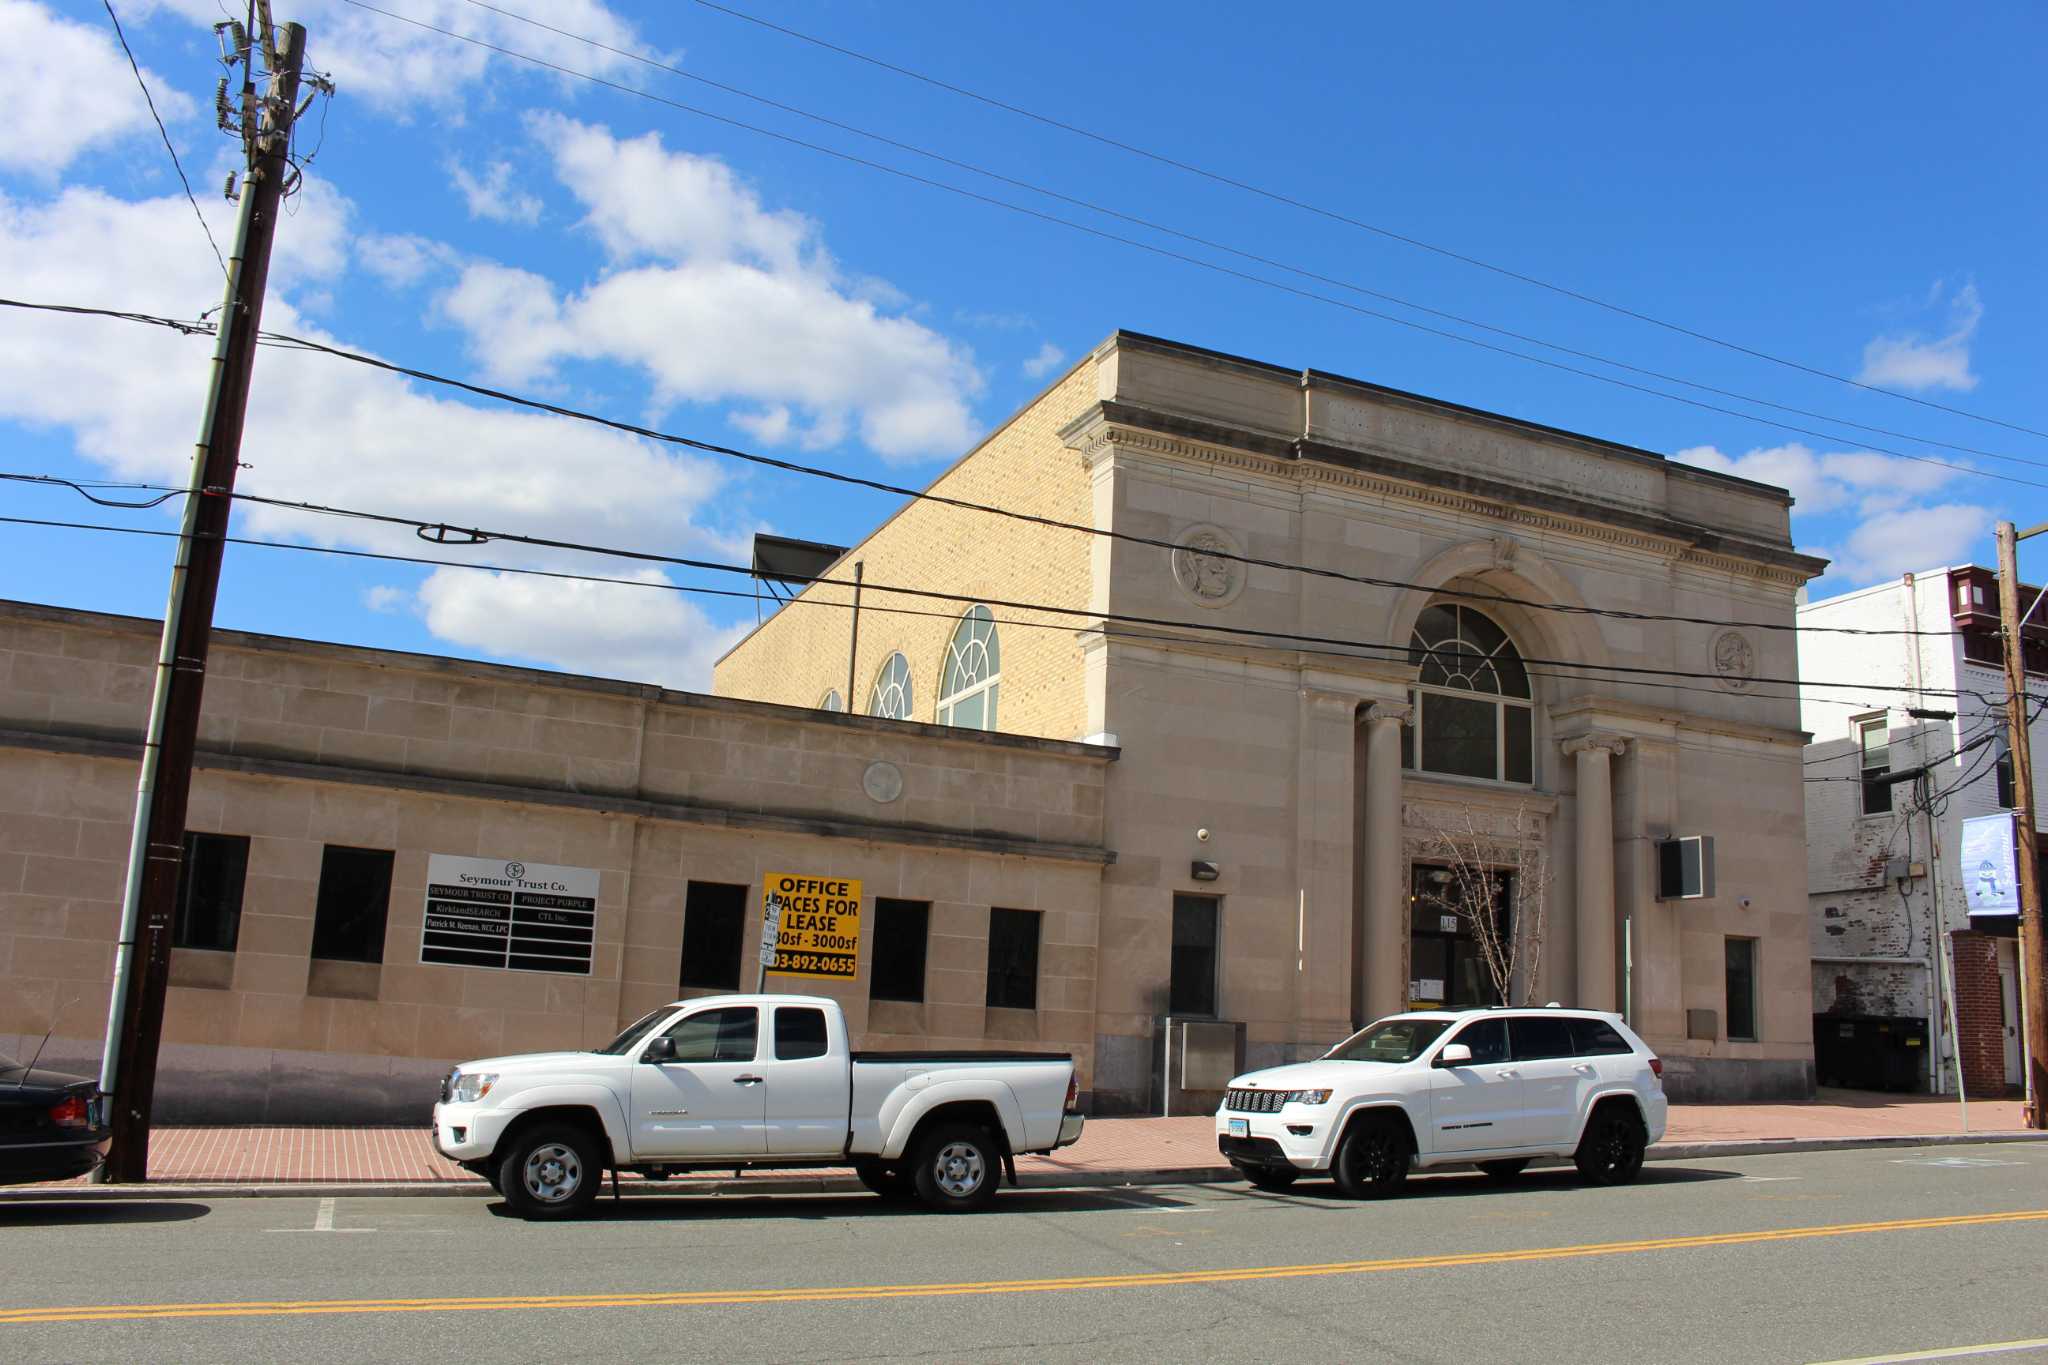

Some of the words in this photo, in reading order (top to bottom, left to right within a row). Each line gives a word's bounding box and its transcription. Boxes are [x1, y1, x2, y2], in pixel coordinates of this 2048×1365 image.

[460, 873, 513, 887] Seymour
[516, 879, 548, 890] Trust
[551, 881, 568, 892] Co.
[780, 878, 849, 896] OFFICE
[430, 886, 469, 897] SEYMOUR
[471, 889, 495, 900] TRUST
[522, 895, 555, 906] PROJECT
[766, 895, 820, 913] PACES
[826, 899, 858, 916] FOR
[787, 914, 837, 932] LEASE
[812, 934, 857, 950] 3000sf
[768, 954, 855, 972] 03-892-0655
